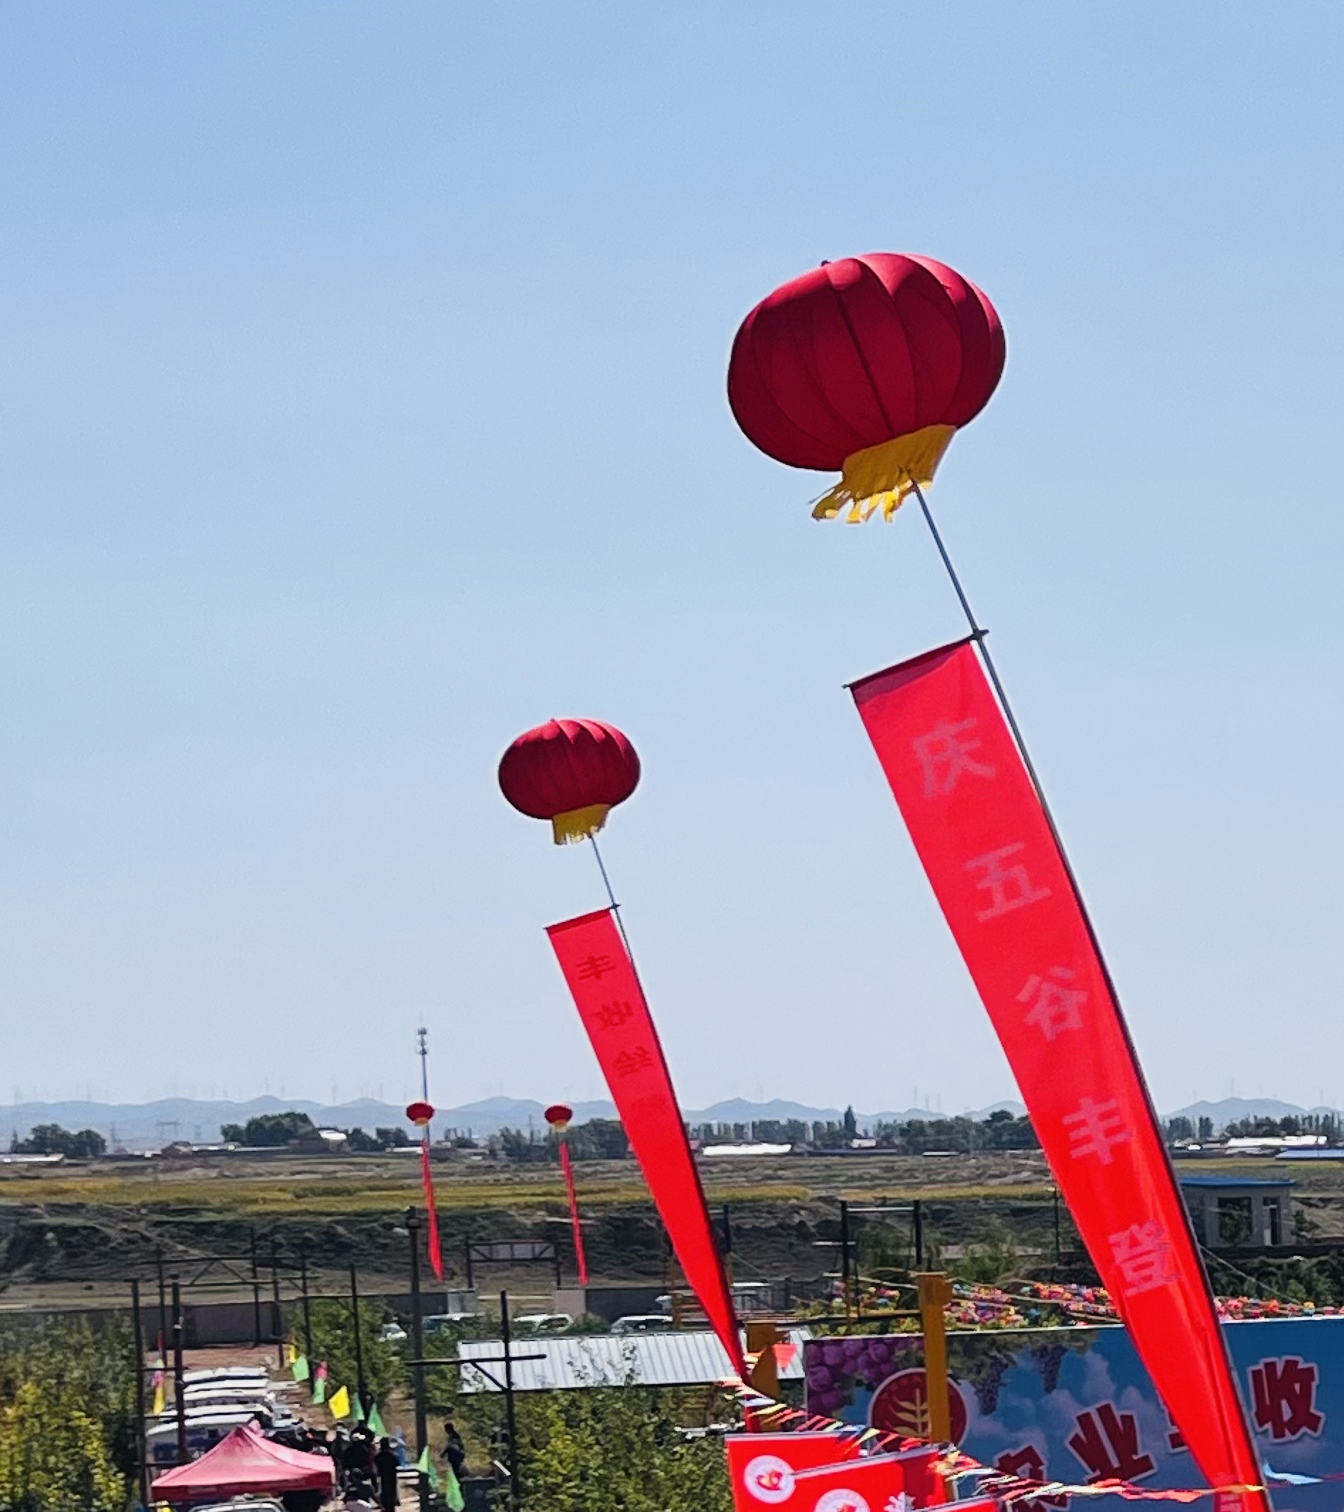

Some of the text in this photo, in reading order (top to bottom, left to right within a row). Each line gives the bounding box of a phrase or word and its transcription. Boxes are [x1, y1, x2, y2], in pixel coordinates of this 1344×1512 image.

[912, 716, 1180, 1298] 庆五谷丰登
